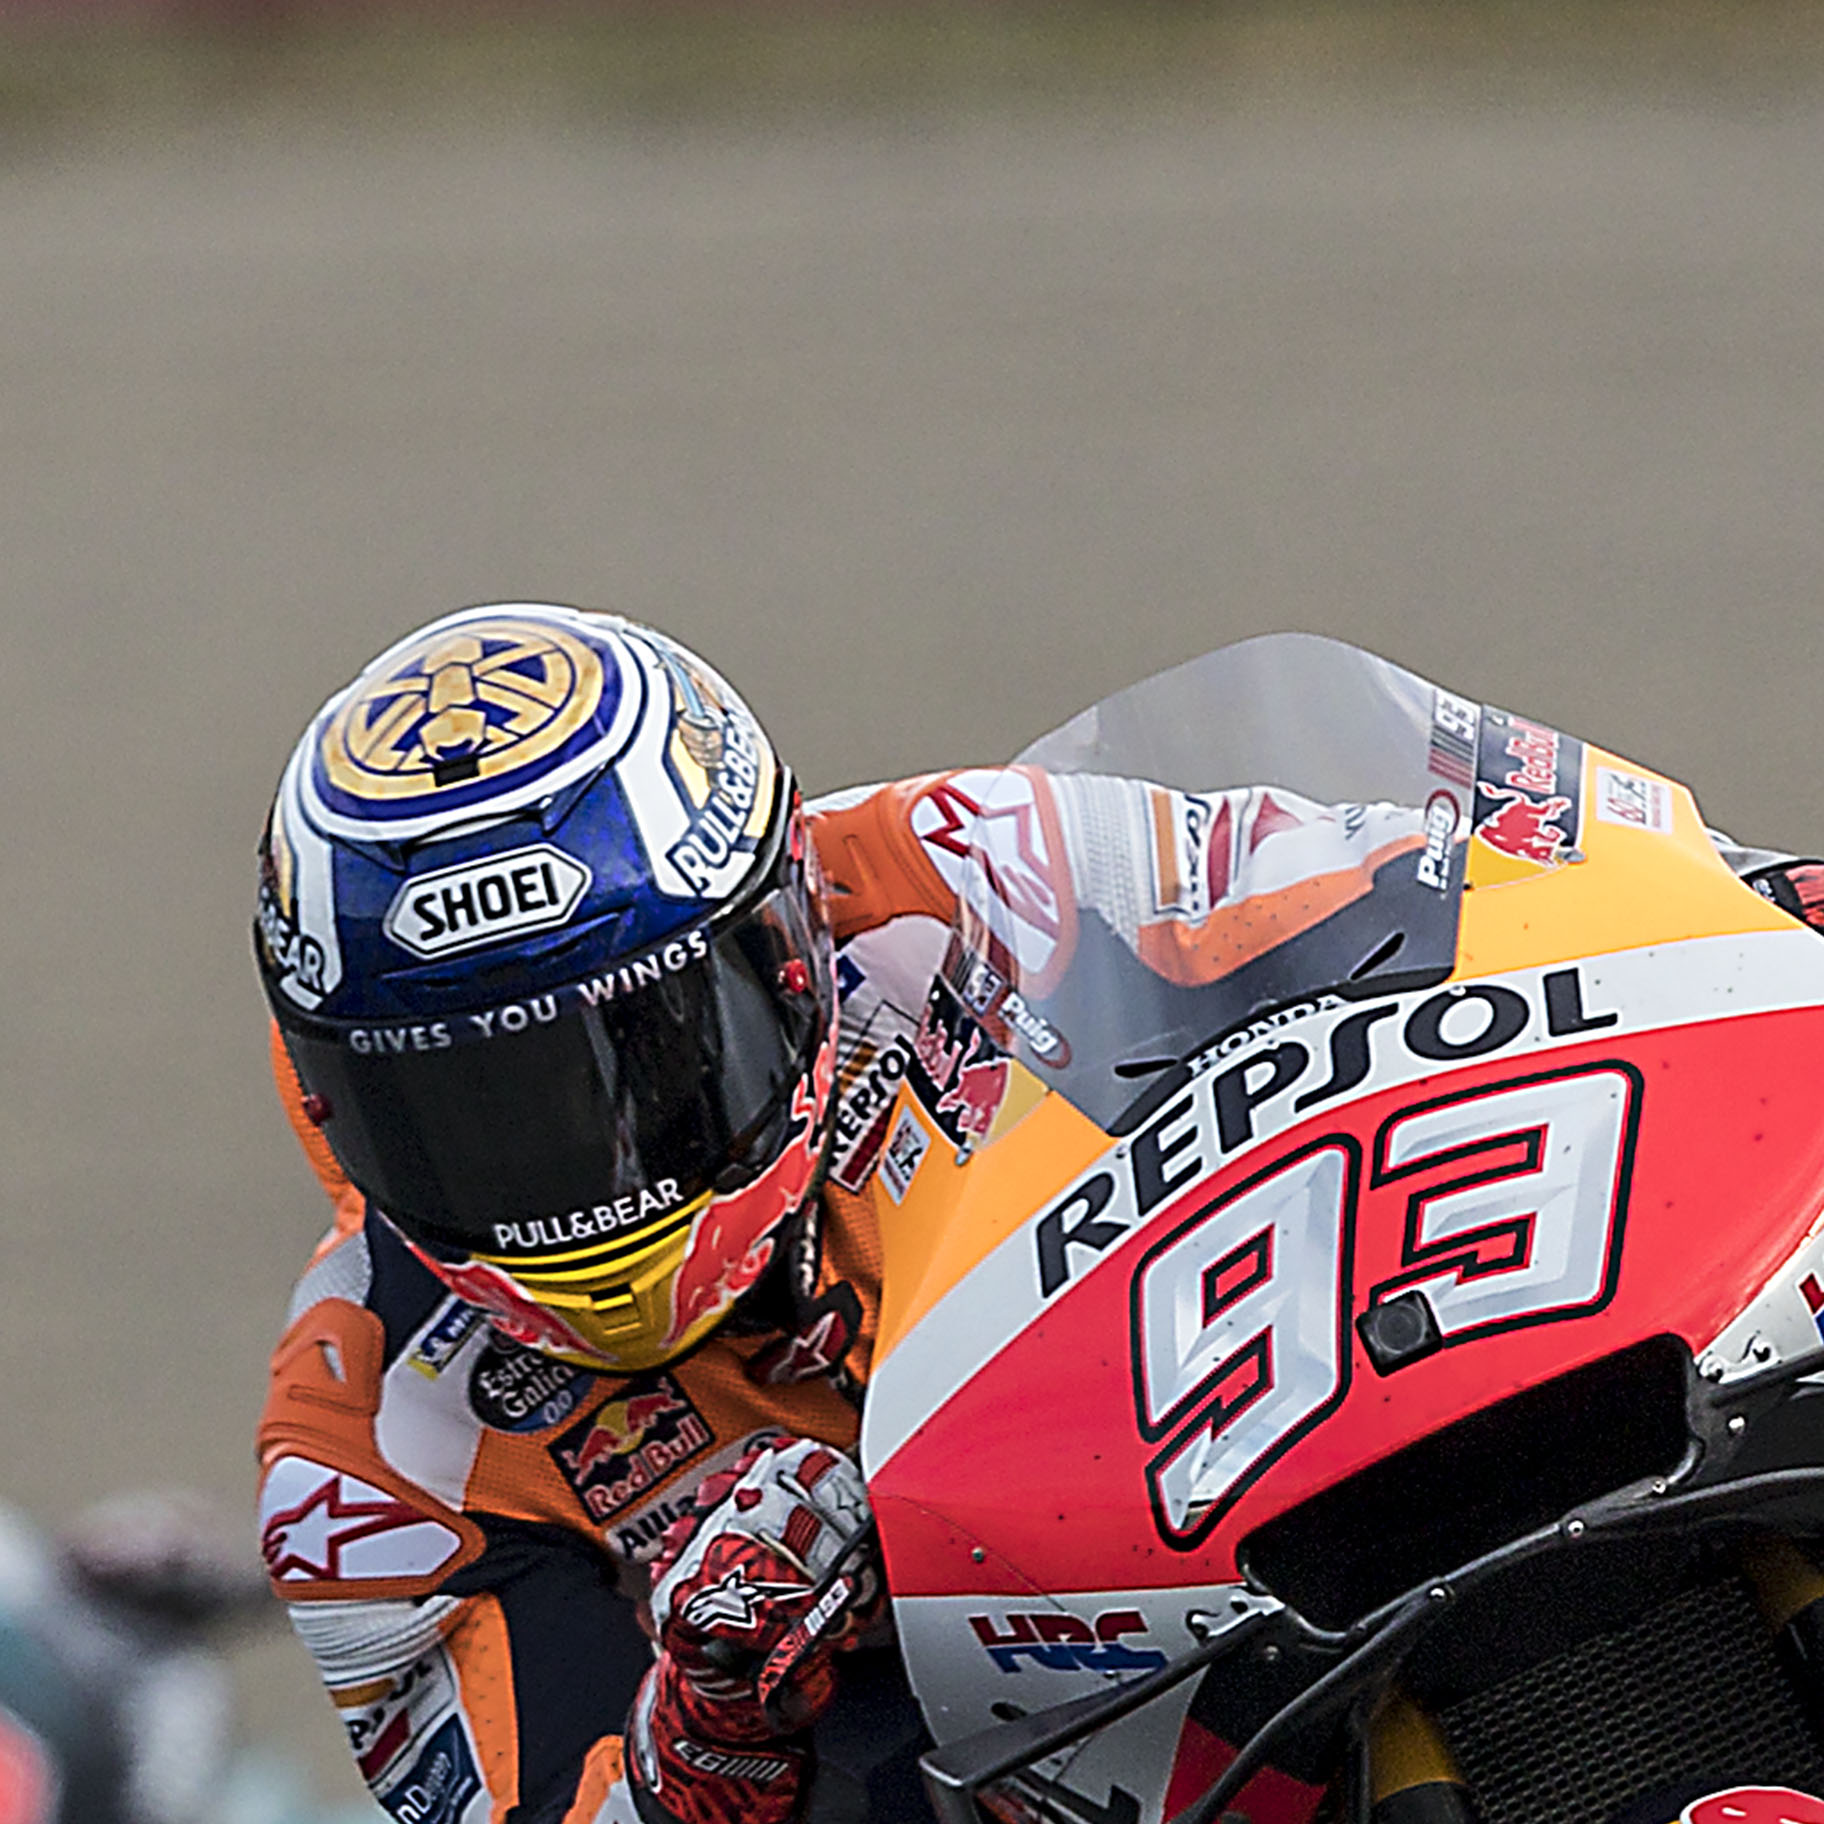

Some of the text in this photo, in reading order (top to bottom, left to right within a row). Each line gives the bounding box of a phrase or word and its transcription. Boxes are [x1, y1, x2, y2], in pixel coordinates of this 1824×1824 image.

[413, 862, 561, 941] SHOEI
[349, 929, 708, 1054] GIVES YOU WINGS
[997, 991, 1059, 1054] Puig
[1189, 993, 1344, 1075] HONDA
[1035, 967, 1619, 1299] REPSOL
[494, 1176, 685, 1251] PULL&BEAR
[1129, 1059, 1644, 1552] 93
[584, 1412, 711, 1519] Red Bull
